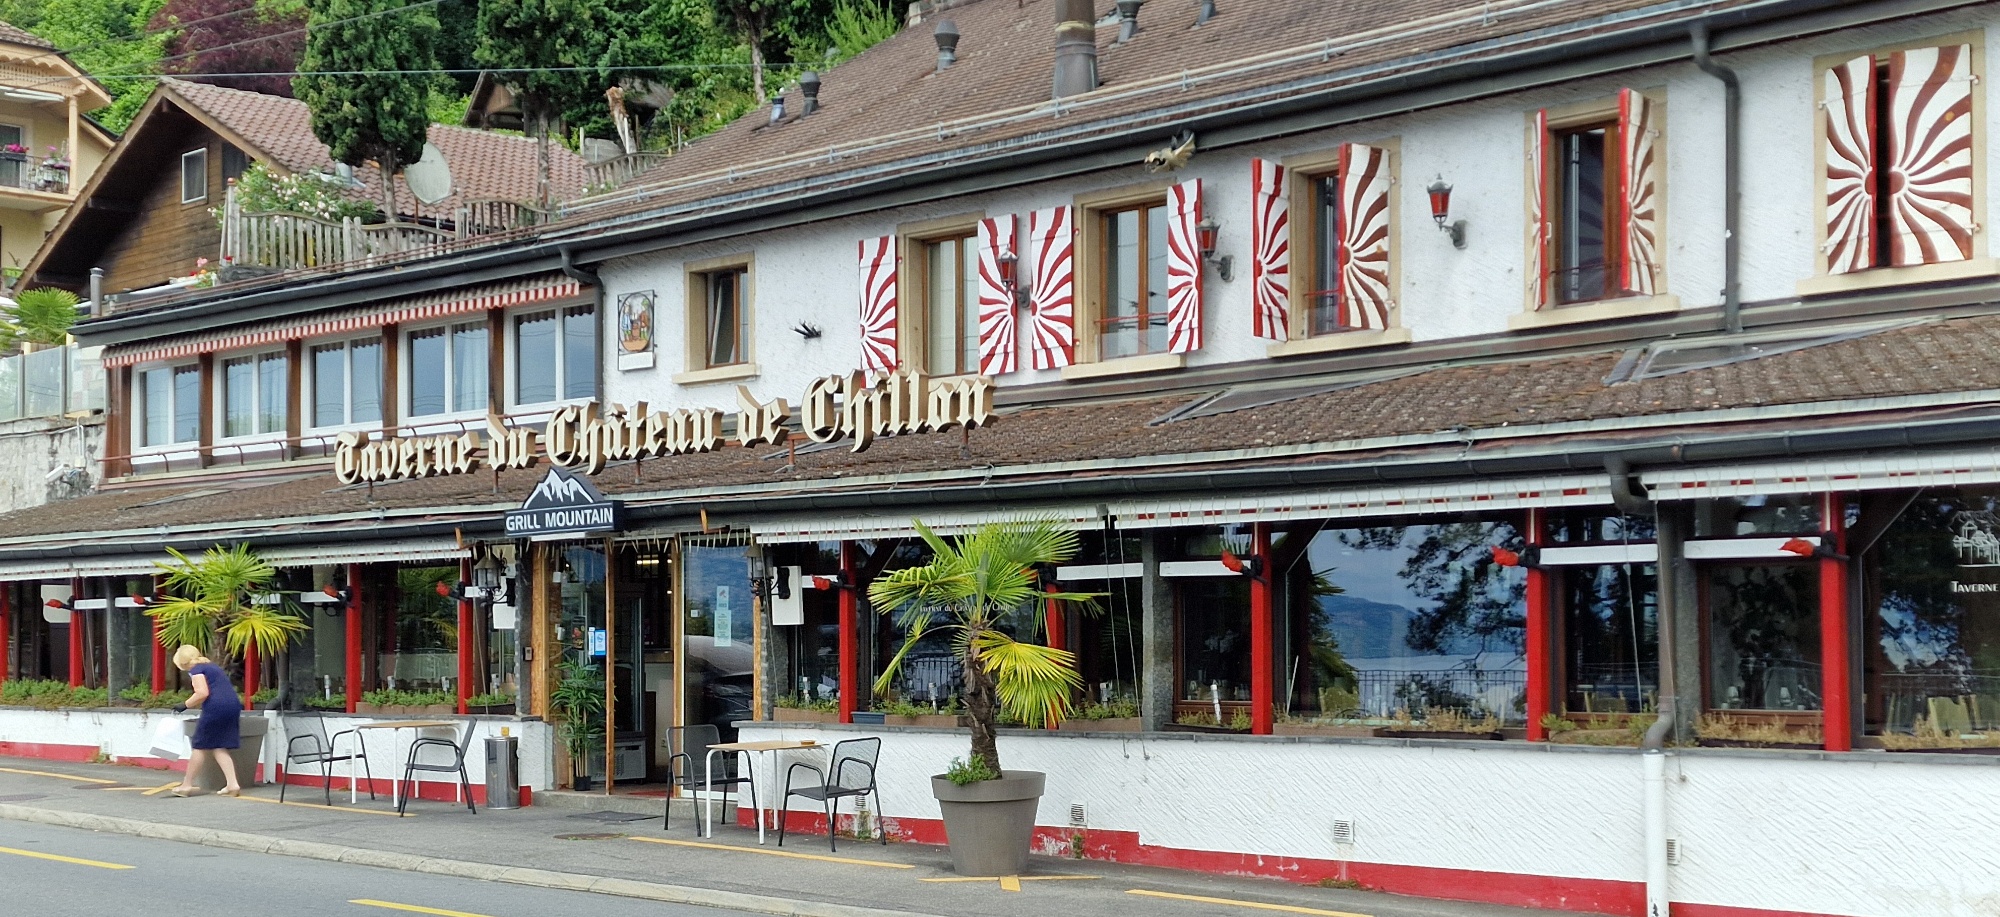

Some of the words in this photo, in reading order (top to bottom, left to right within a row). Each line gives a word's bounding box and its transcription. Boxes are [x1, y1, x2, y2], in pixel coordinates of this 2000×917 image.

[334, 430, 480, 485] Taverne
[486, 415, 539, 471] du
[545, 401, 724, 475] Château
[736, 385, 790, 448] de
[801, 368, 998, 453] Chillon
[505, 513, 541, 531] GRILL
[545, 507, 614, 528] MOUNTAIN
[1950, 580, 1999, 593] TAVERNE
